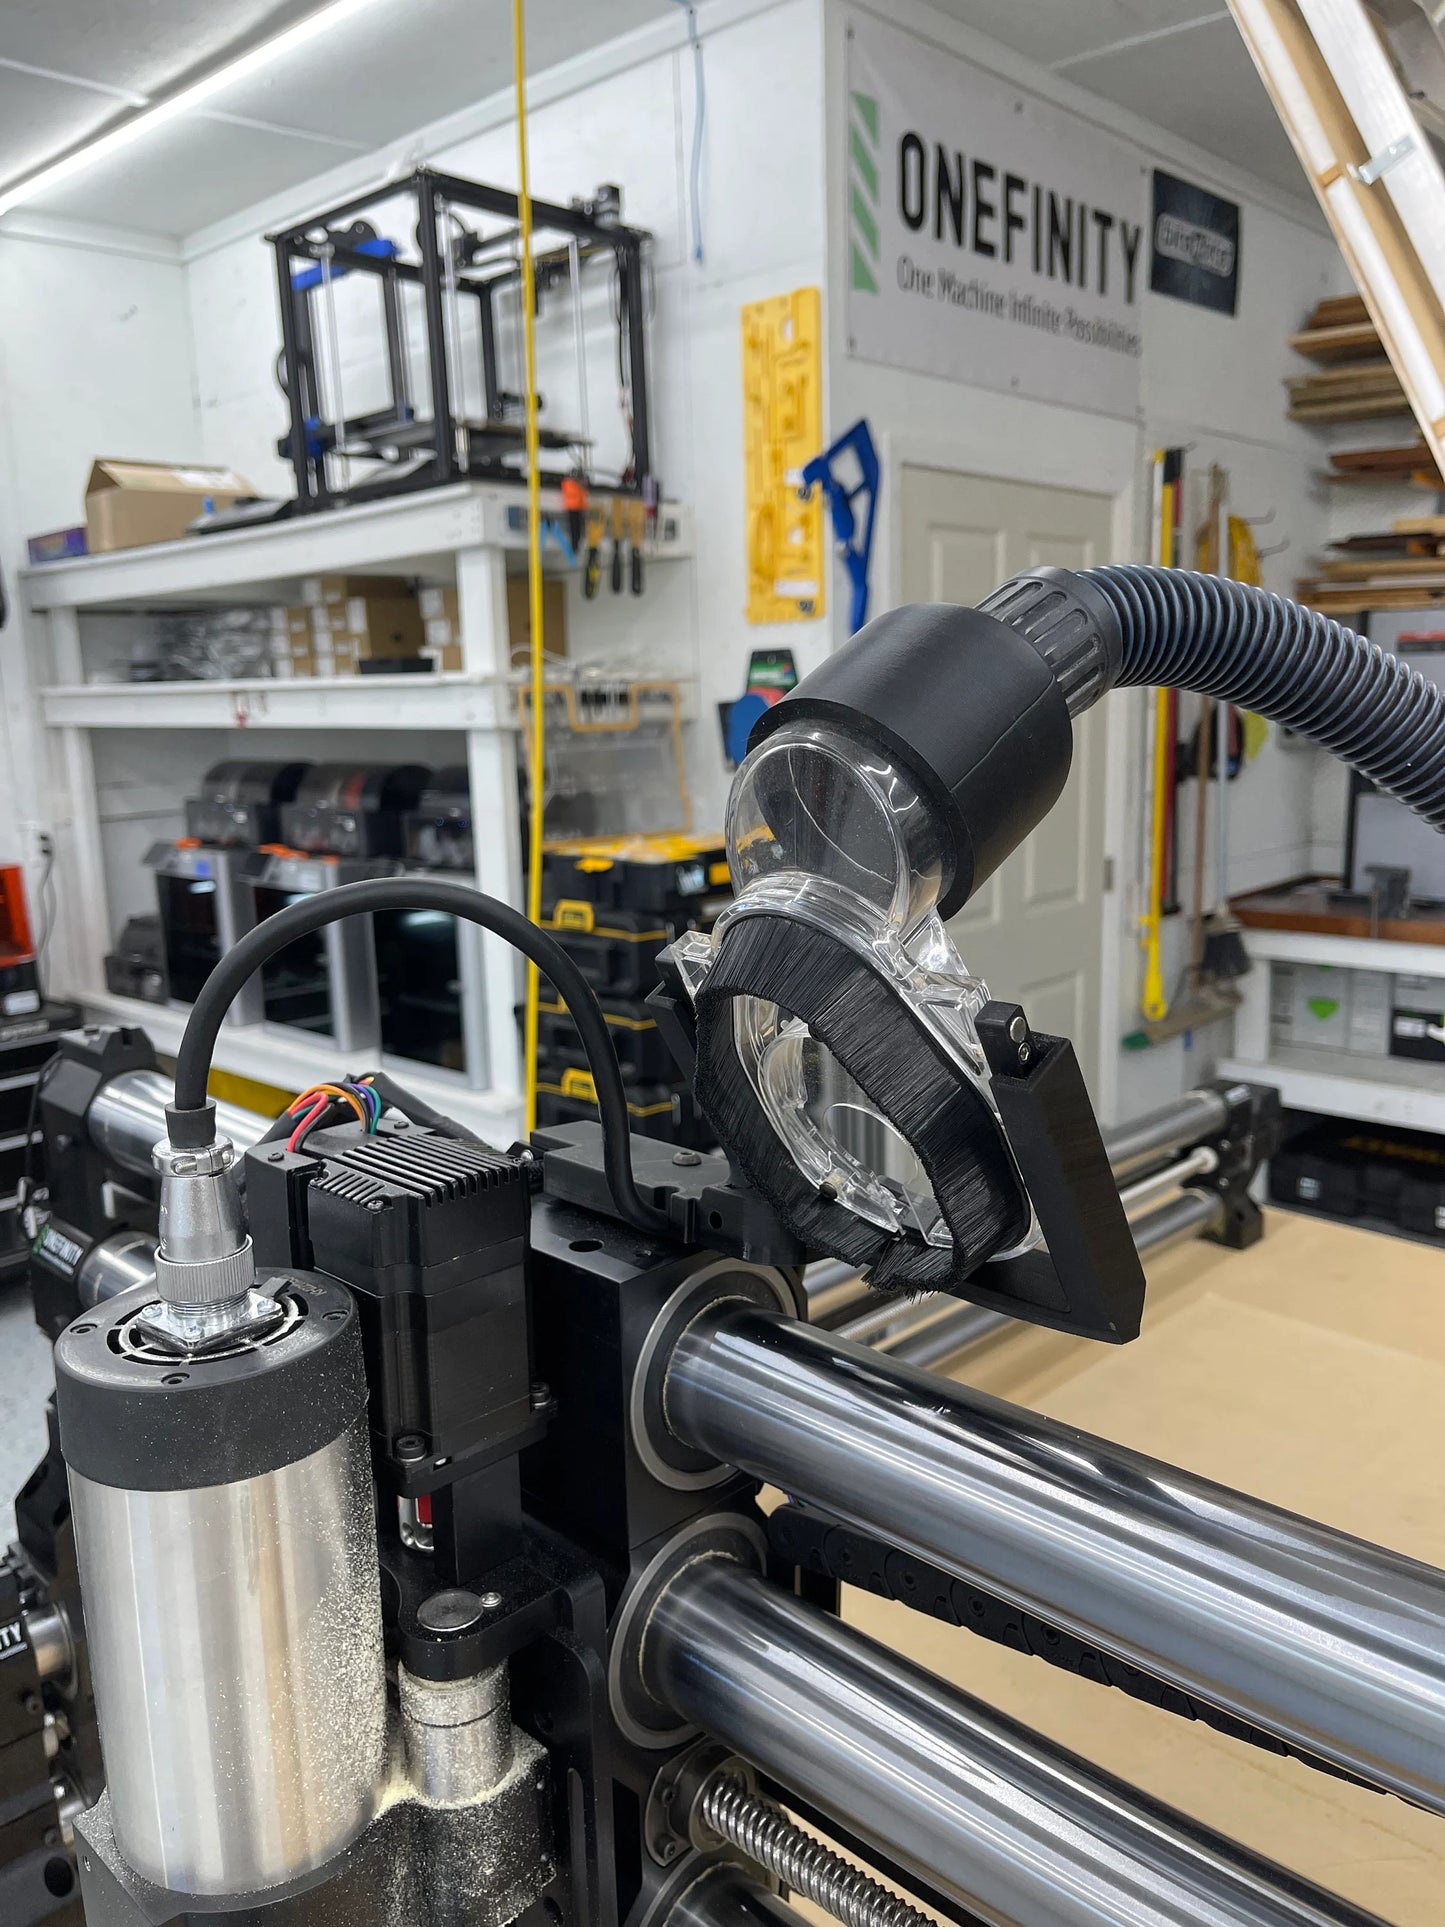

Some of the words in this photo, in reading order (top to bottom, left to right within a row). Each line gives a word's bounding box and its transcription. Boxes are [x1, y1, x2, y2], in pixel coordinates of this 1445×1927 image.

[899, 131, 1142, 304] ONEFINITY
[897, 256, 935, 299] One
[937, 267, 1004, 319] Machine
